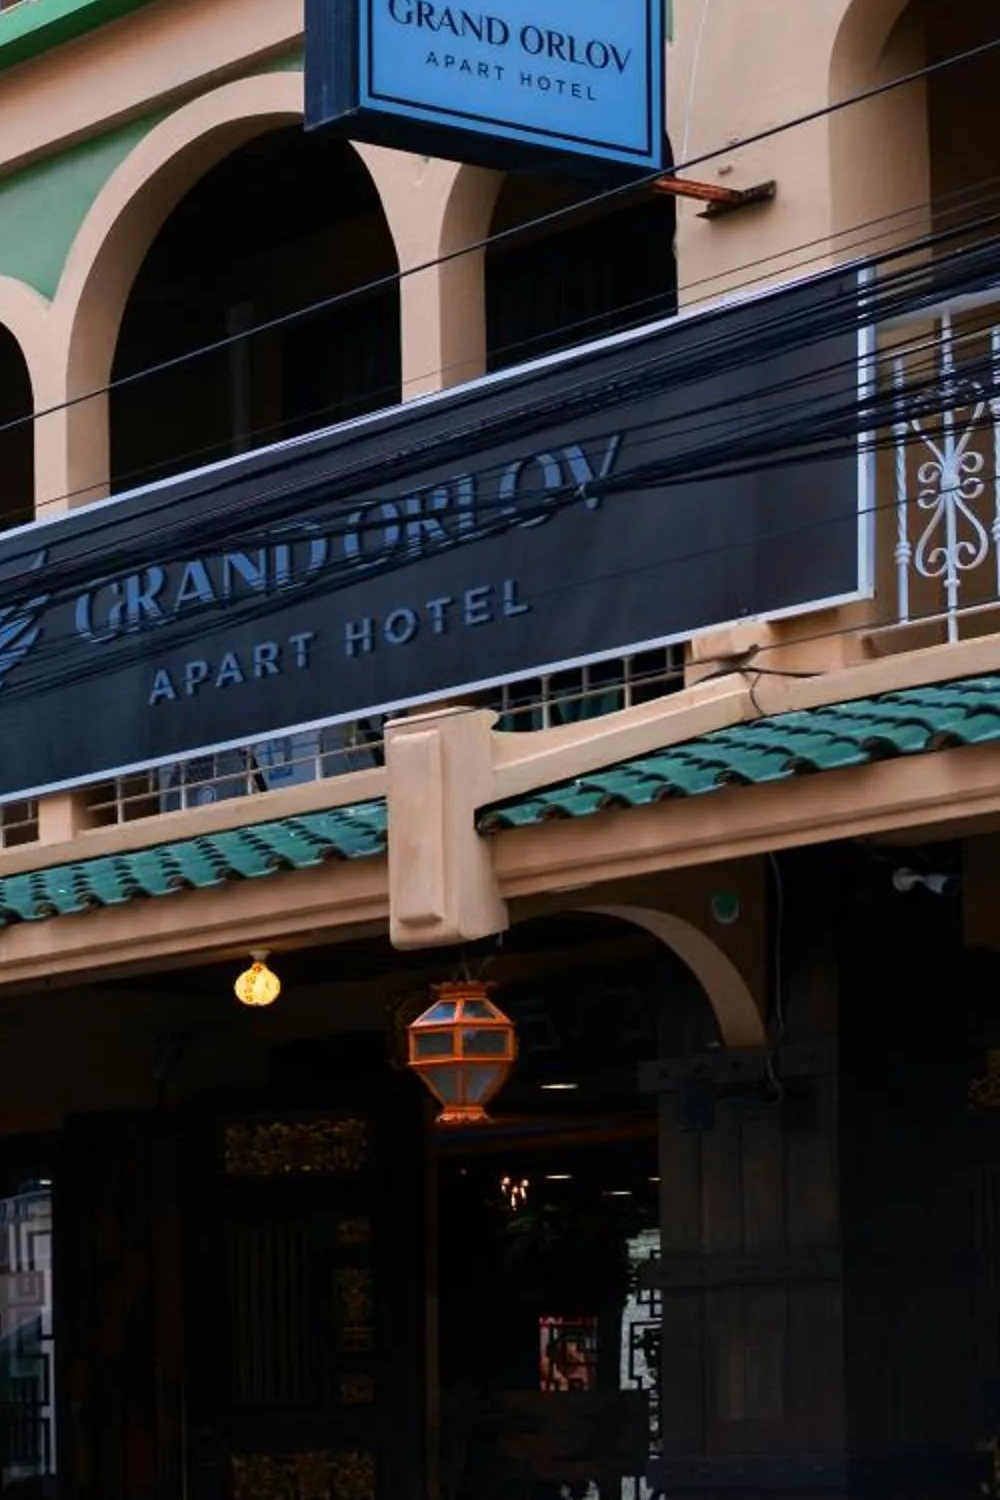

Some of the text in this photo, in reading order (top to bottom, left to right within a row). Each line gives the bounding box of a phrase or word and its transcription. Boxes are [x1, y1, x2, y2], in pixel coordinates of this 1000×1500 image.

[425, 51, 597, 101] APART HOTEL
[520, 25, 632, 74] ORLOV
[75, 519, 327, 642] GRAND
[149, 578, 531, 705] APART HOTEL
